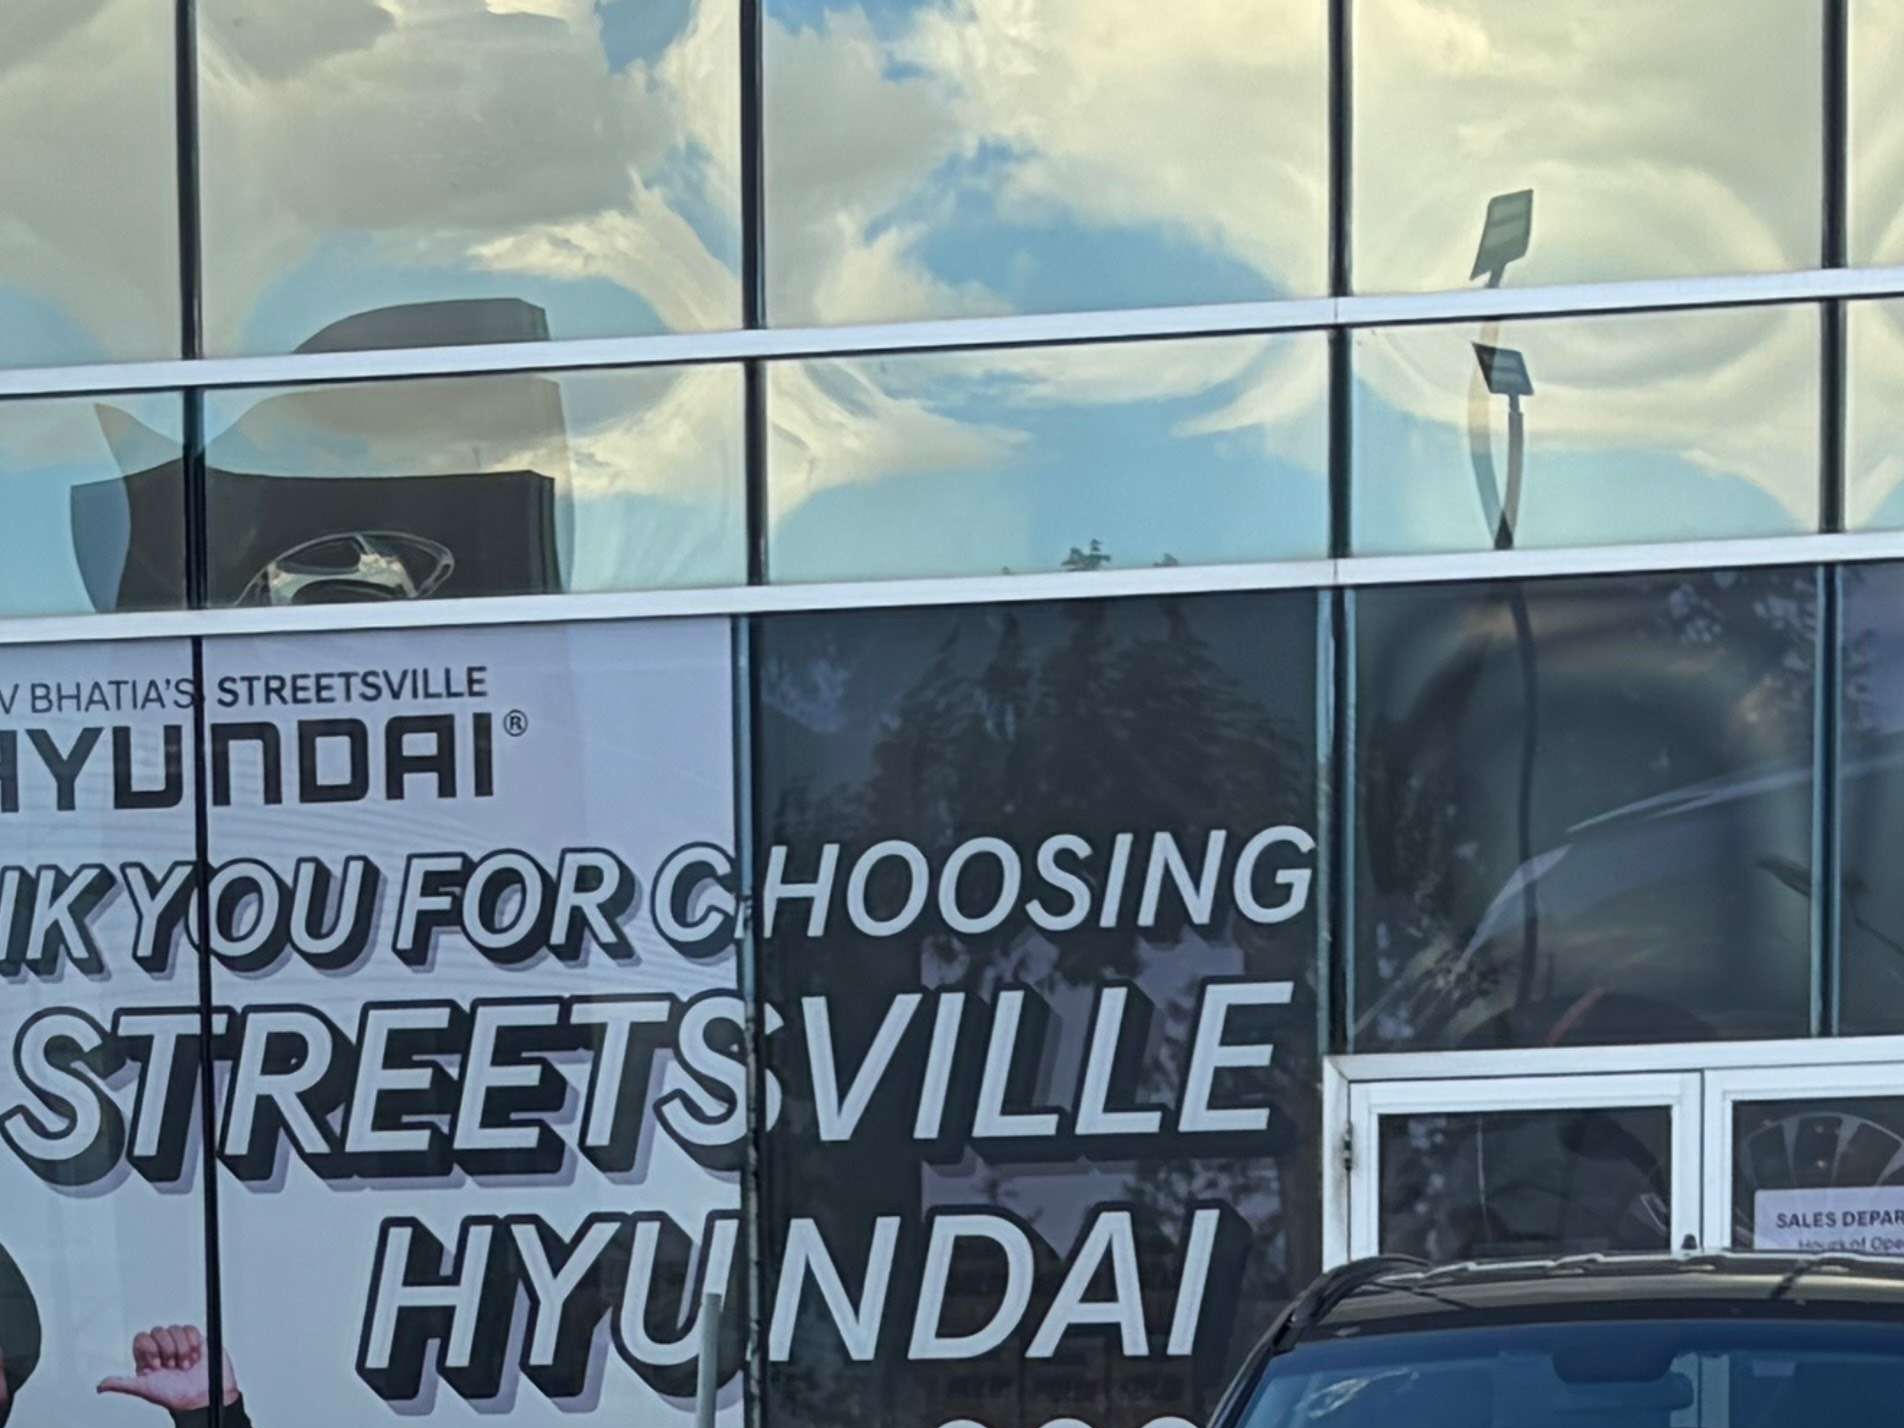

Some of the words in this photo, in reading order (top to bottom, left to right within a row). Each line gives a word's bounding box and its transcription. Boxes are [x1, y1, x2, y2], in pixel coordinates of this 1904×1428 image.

[31, 678, 196, 713] BHATIA'S
[216, 667, 488, 708] STREETSVILLE
[120, 855, 376, 970] YOU
[393, 846, 634, 960] FOR
[650, 824, 1316, 952] CHOOSING
[1776, 1211, 1837, 1229] SALES
[356, 1207, 1226, 1398] HYUNDAI
